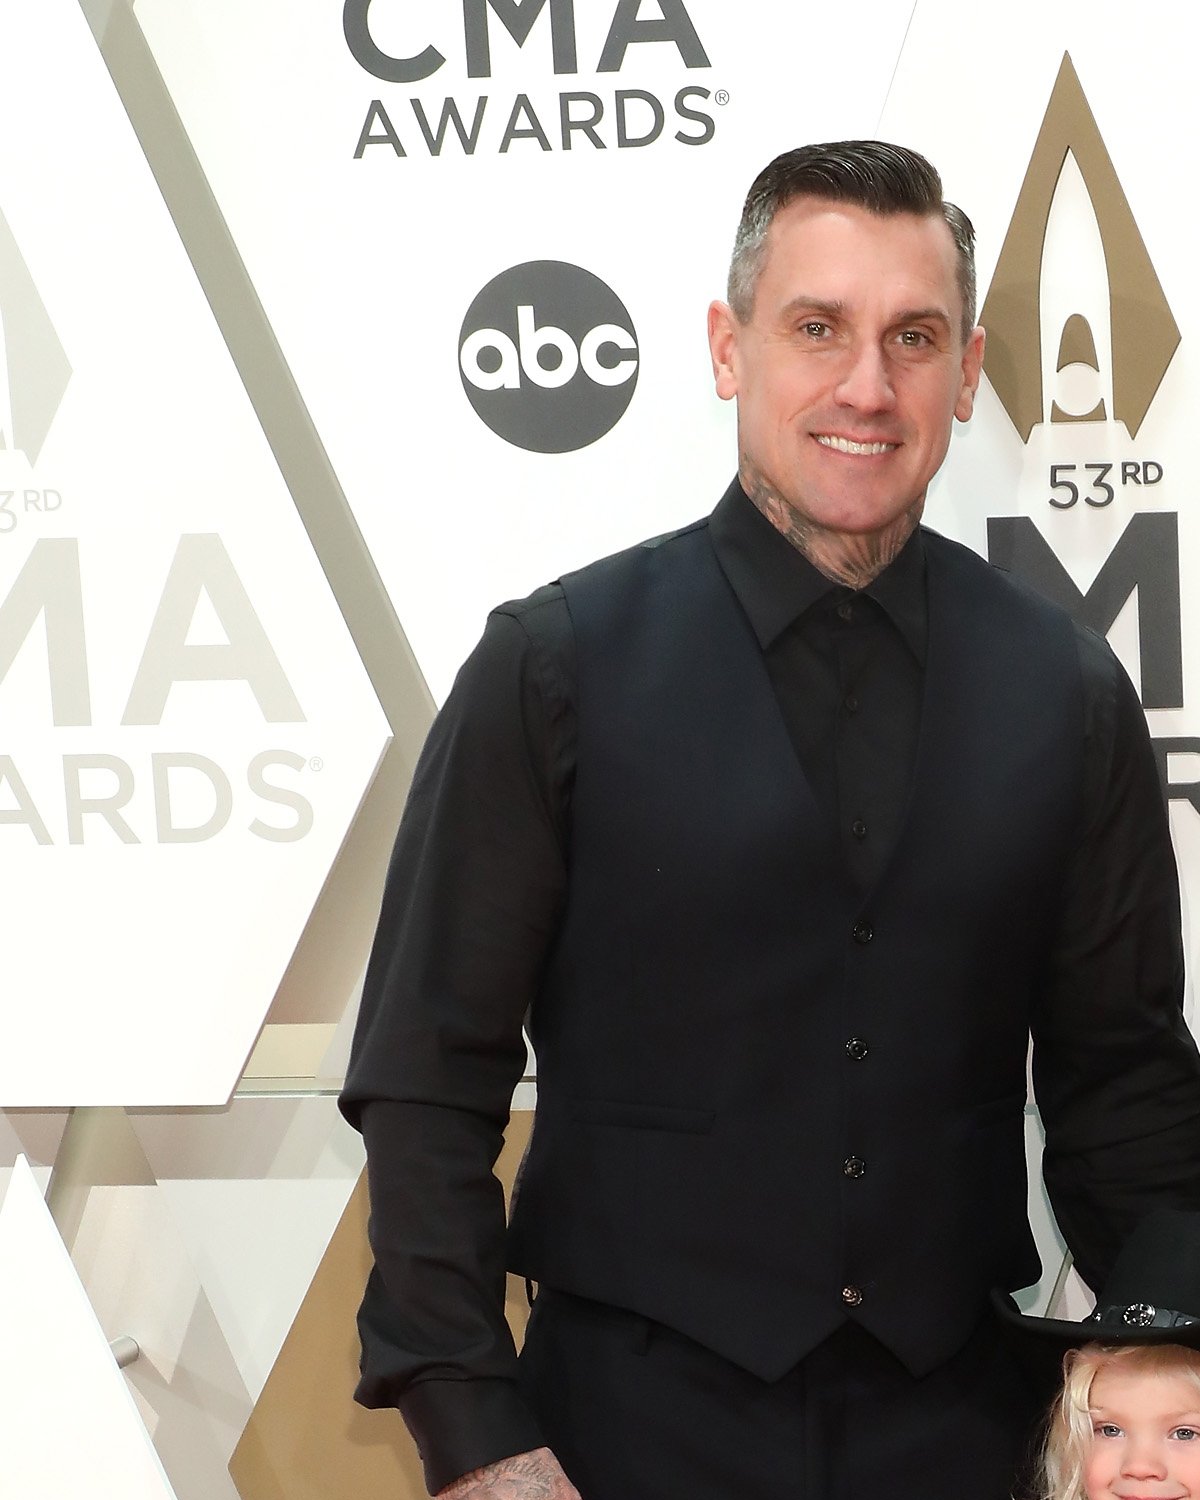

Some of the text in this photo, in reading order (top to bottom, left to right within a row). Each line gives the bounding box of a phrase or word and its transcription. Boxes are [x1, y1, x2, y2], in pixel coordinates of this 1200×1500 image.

[343, 0, 712, 83] CMA
[460, 305, 639, 390] abc
[1049, 461, 1163, 509] 53RD
